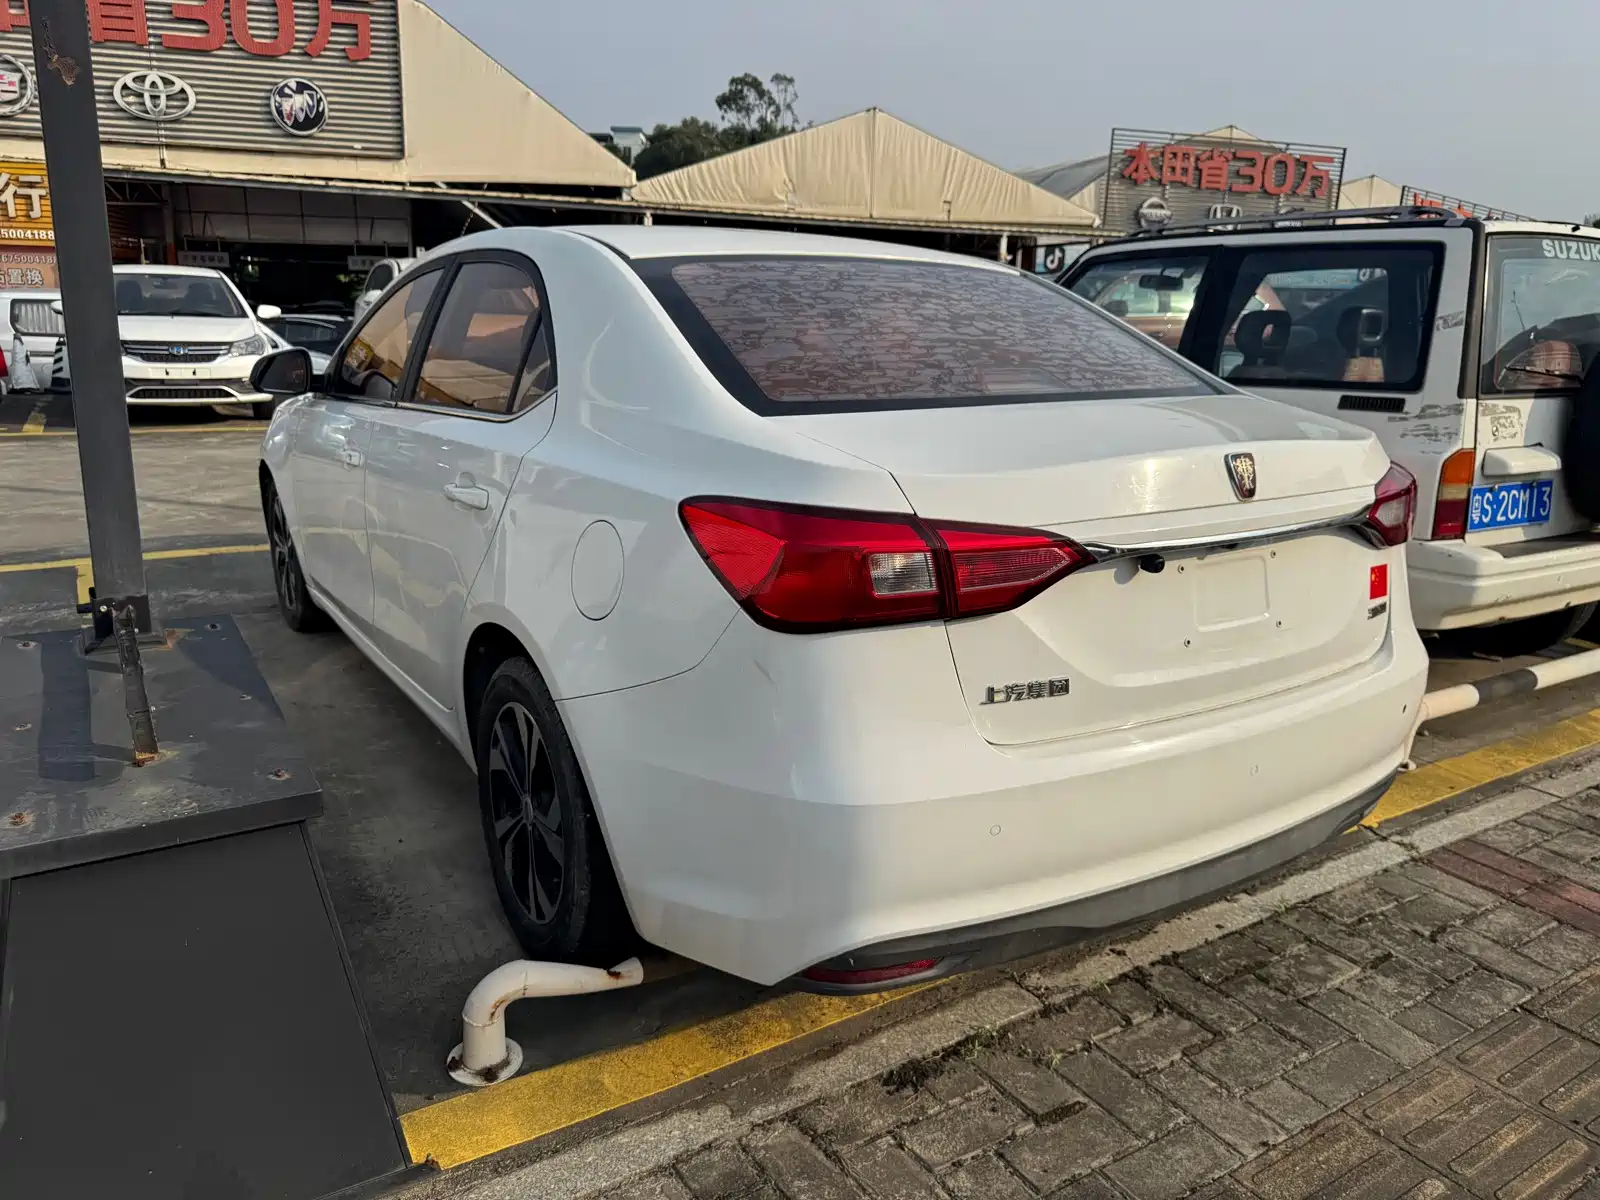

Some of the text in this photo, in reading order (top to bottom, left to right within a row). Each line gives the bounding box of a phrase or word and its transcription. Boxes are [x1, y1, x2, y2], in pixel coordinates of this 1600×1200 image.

[1123, 142, 1334, 197] 本田省30万
[0, 172, 47, 219] 行
[0, 229, 55, 240] 5004188
[979, 678, 1068, 705] 上汽集团
